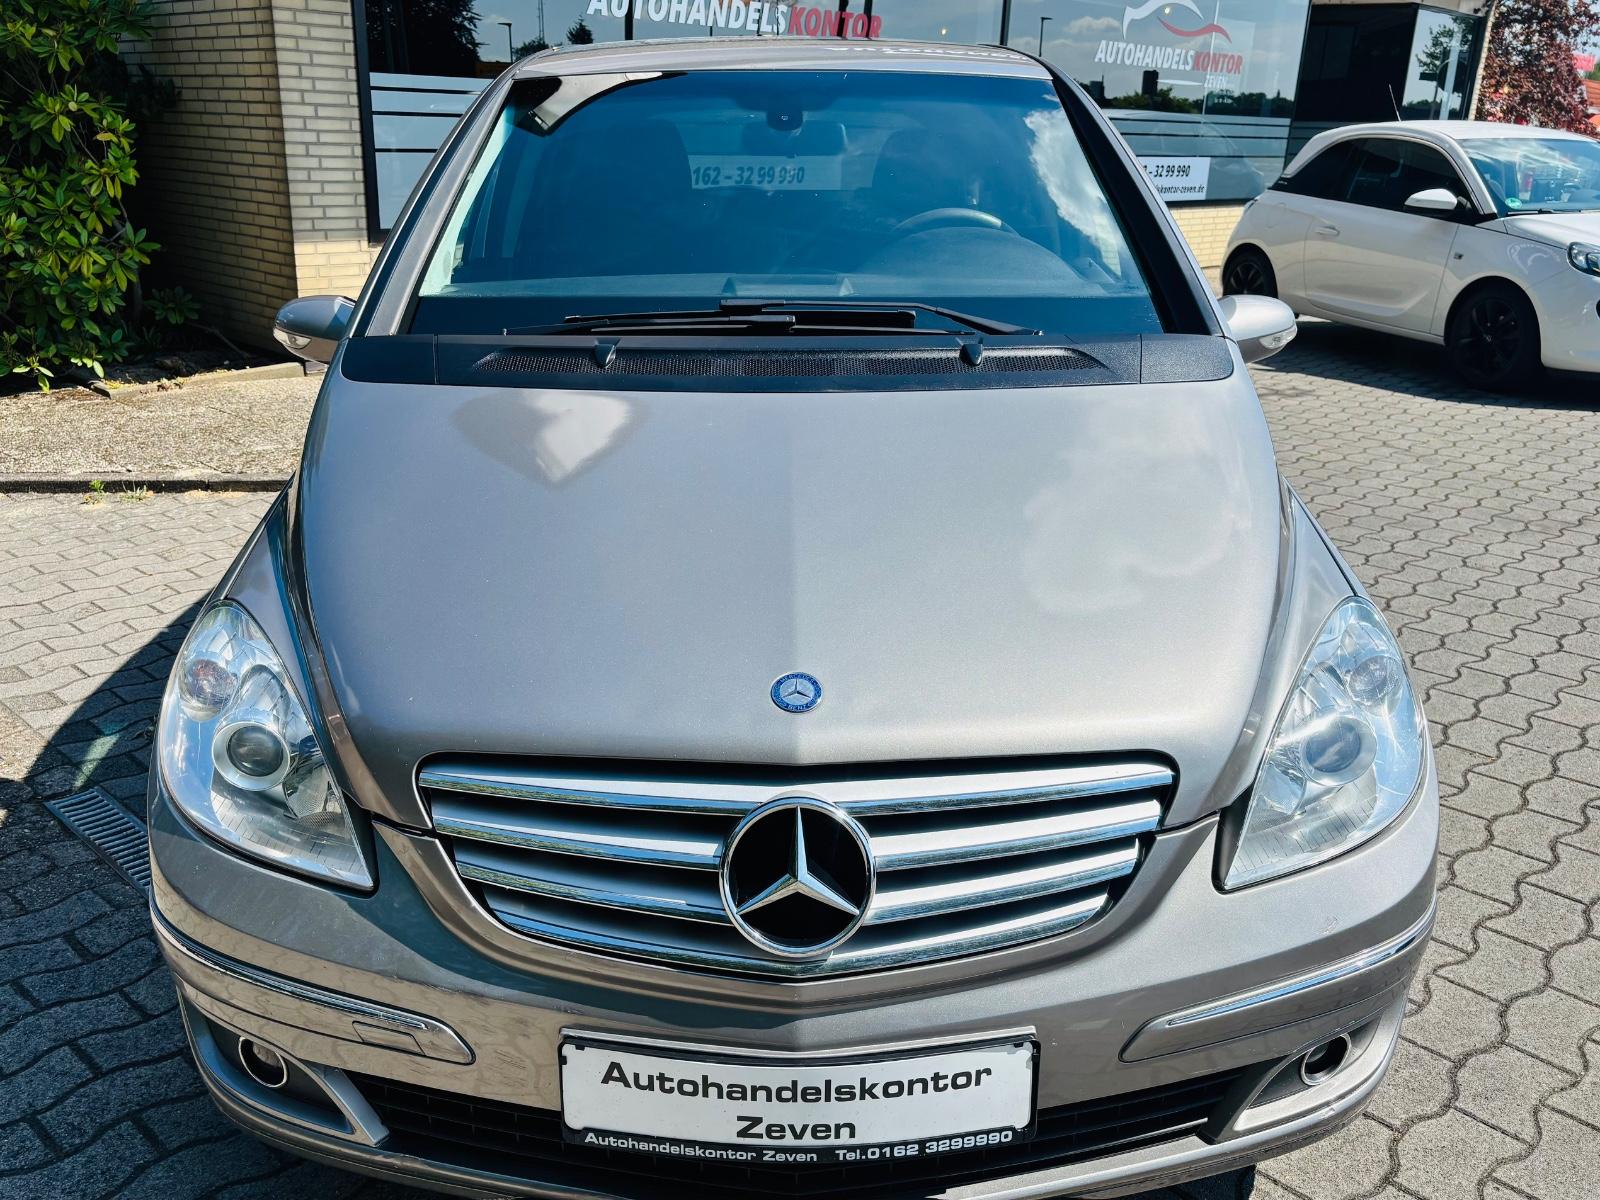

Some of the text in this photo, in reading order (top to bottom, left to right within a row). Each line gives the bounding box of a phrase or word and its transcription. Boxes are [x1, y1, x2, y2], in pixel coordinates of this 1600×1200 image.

[1094, 39, 1244, 75] AUTOHANDELSKONTOR
[735, 166, 754, 185] 32
[757, 166, 775, 185] 99
[1154, 164, 1164, 177] 32
[600, 1061, 992, 1103] Autohandelskontor
[736, 1115, 856, 1140] Zeven
[584, 1132, 757, 1161] Autohandelskontor
[762, 1149, 818, 1162] Zeven
[925, 1130, 1013, 1154] 3299990
